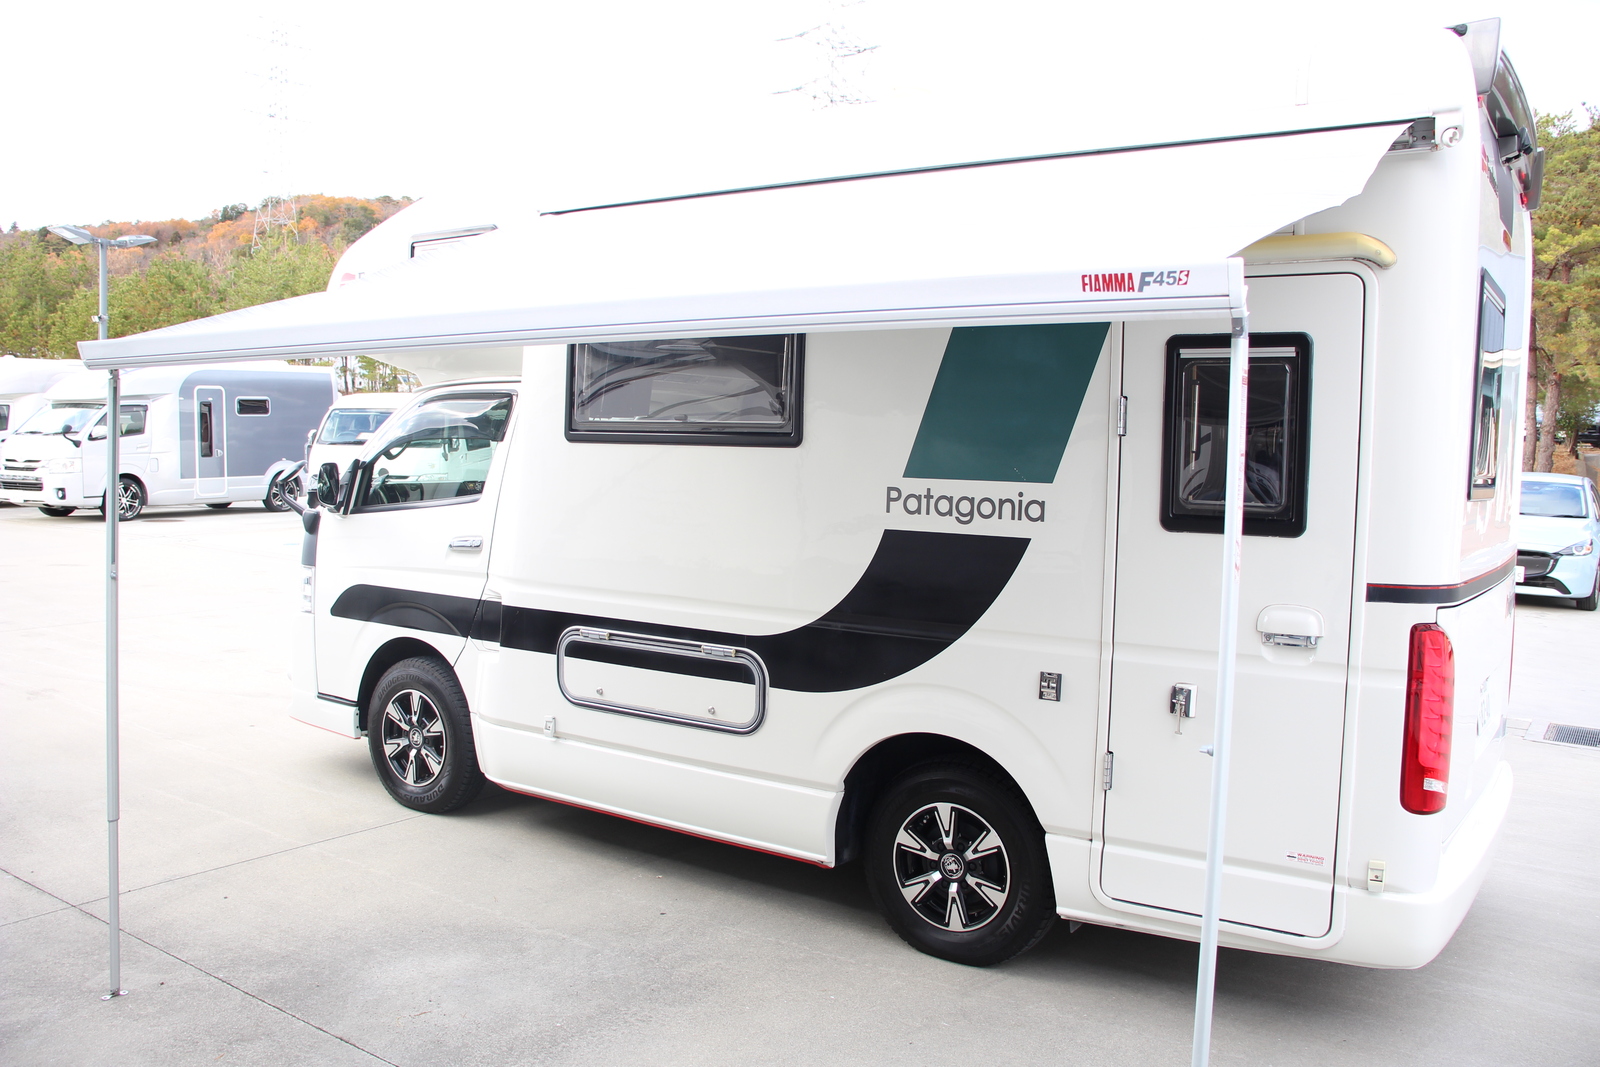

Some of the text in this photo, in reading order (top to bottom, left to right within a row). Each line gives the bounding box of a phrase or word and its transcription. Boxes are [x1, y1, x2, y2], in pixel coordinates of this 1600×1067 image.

[1081, 272, 1135, 293] FIAMMA
[885, 486, 1046, 525] Patagonia
[403, 782, 445, 803] DURAVIS
